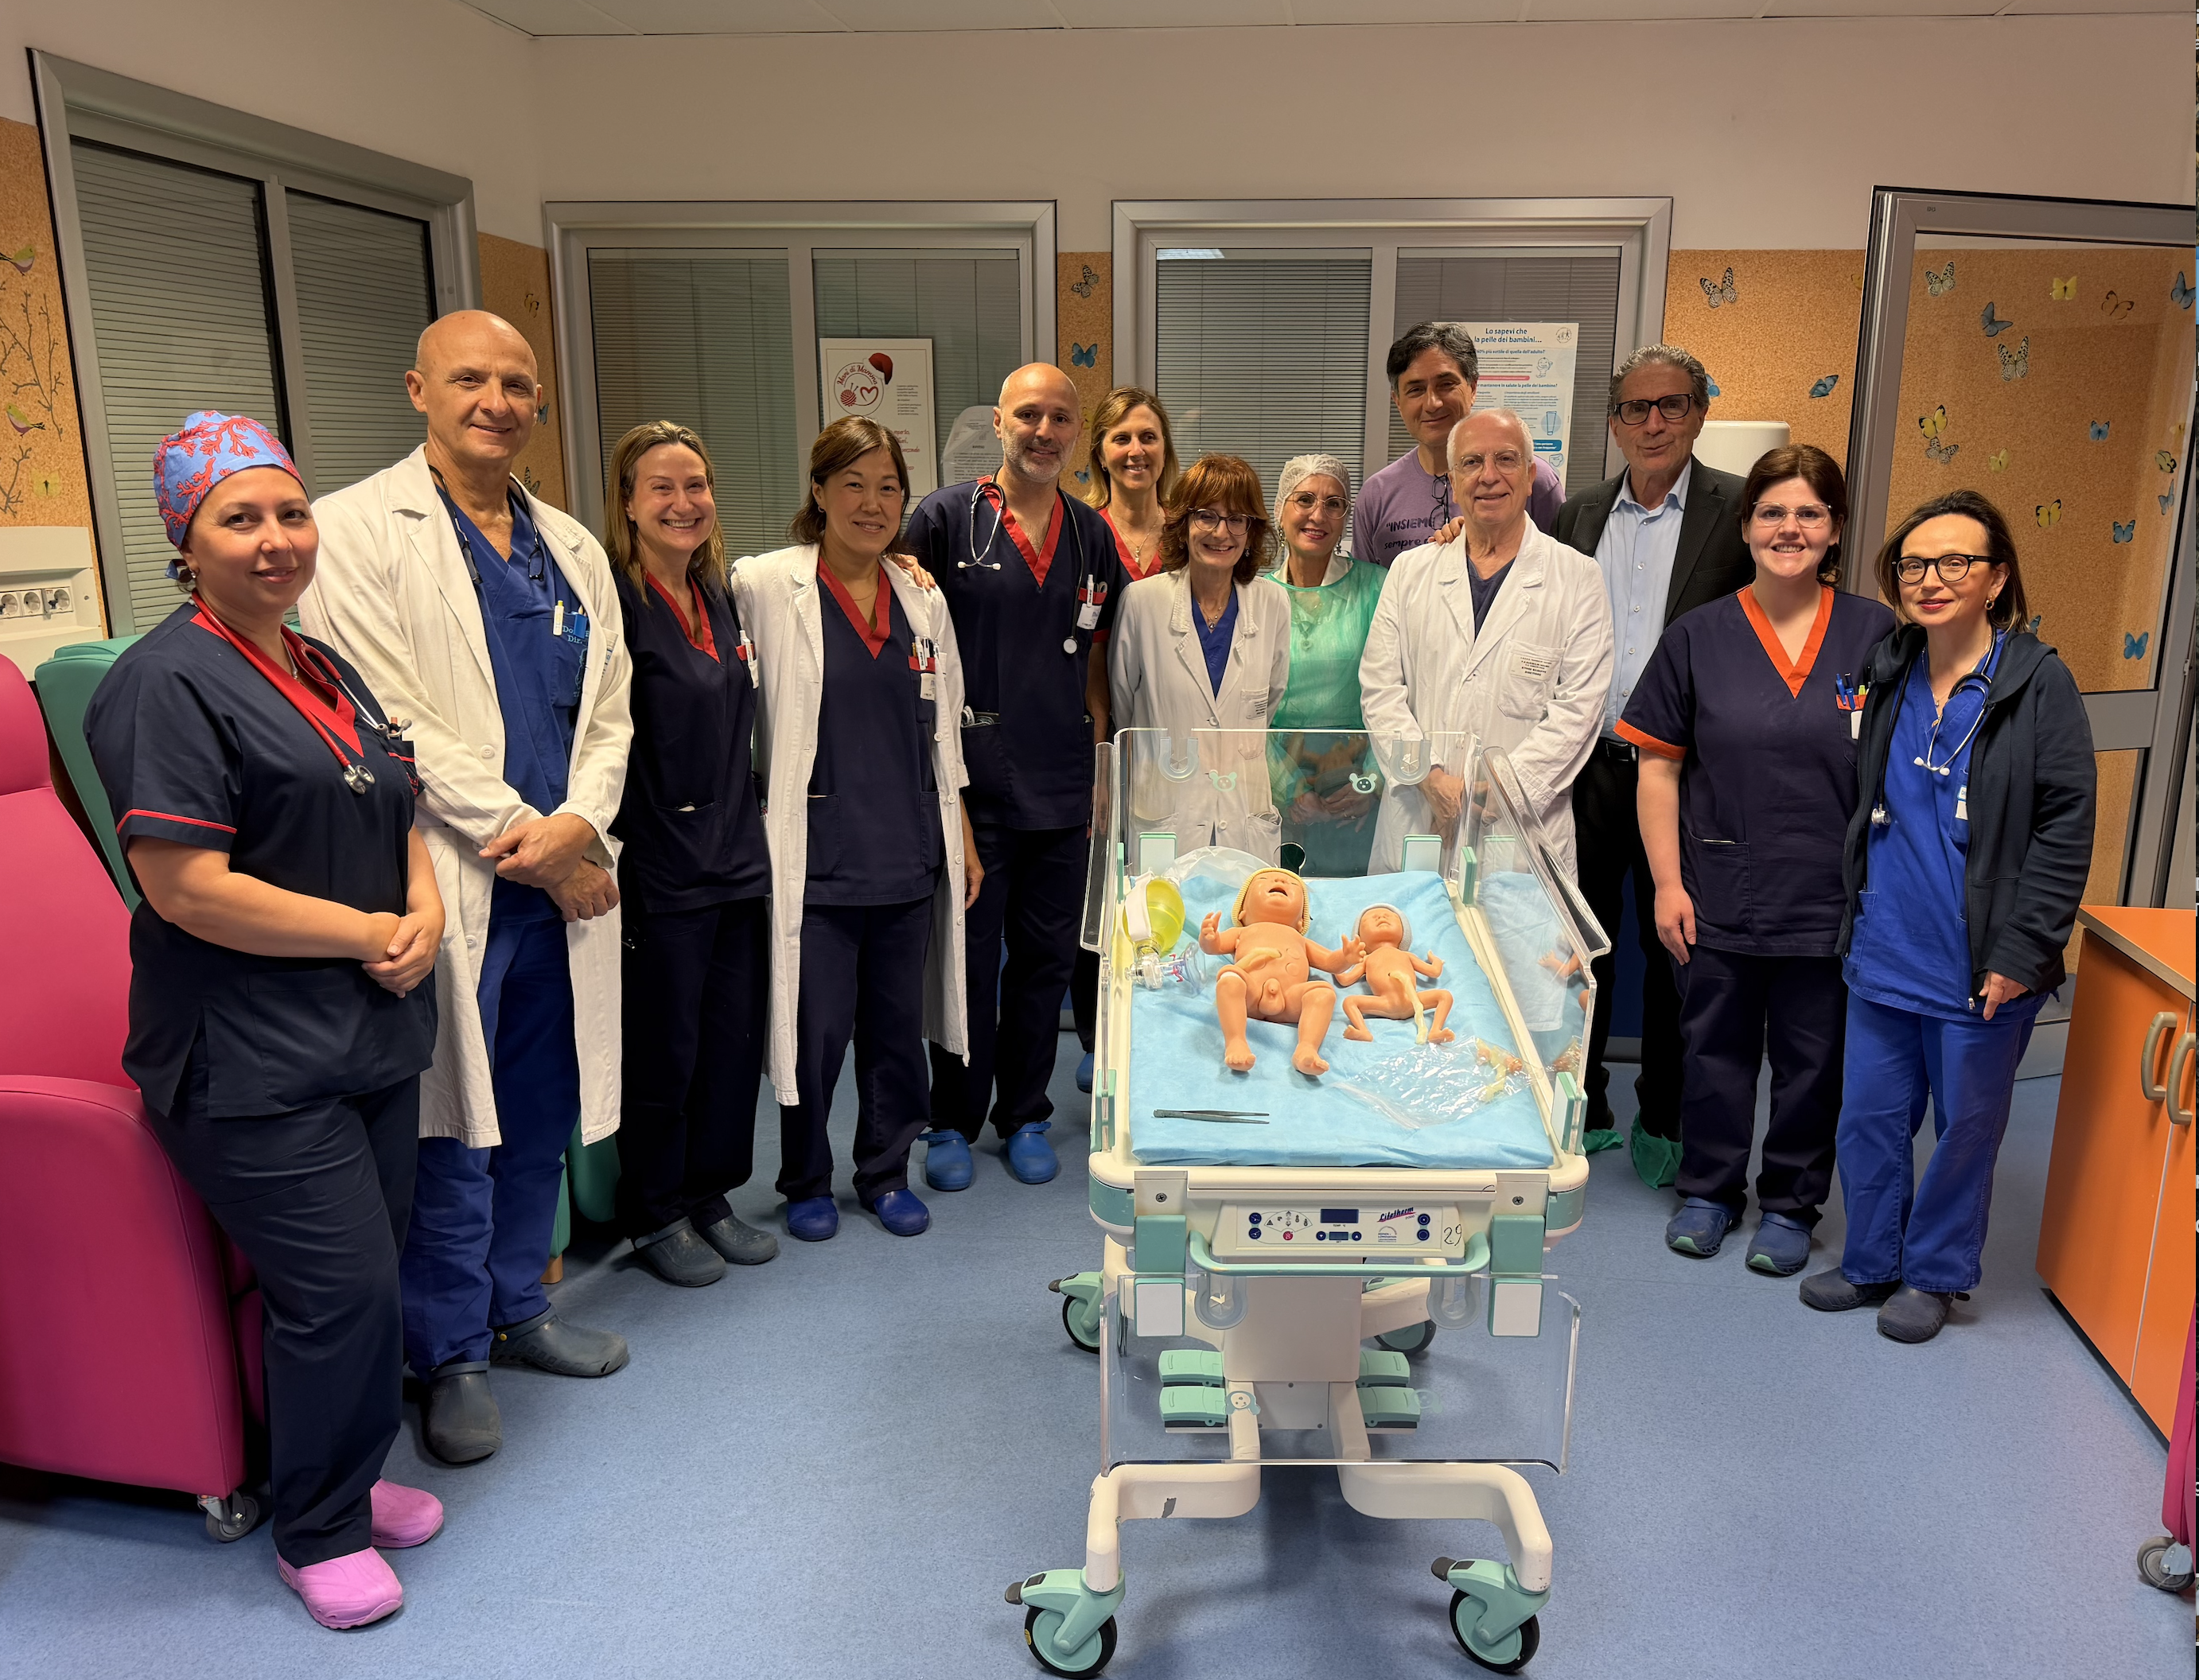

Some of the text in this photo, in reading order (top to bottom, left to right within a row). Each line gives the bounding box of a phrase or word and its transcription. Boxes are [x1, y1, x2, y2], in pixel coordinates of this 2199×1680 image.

[837, 368, 850, 385] Mani
[857, 365, 878, 385] Mamma
[1384, 539, 1422, 550] sempre
[1443, 1223, 1462, 1246] 29
